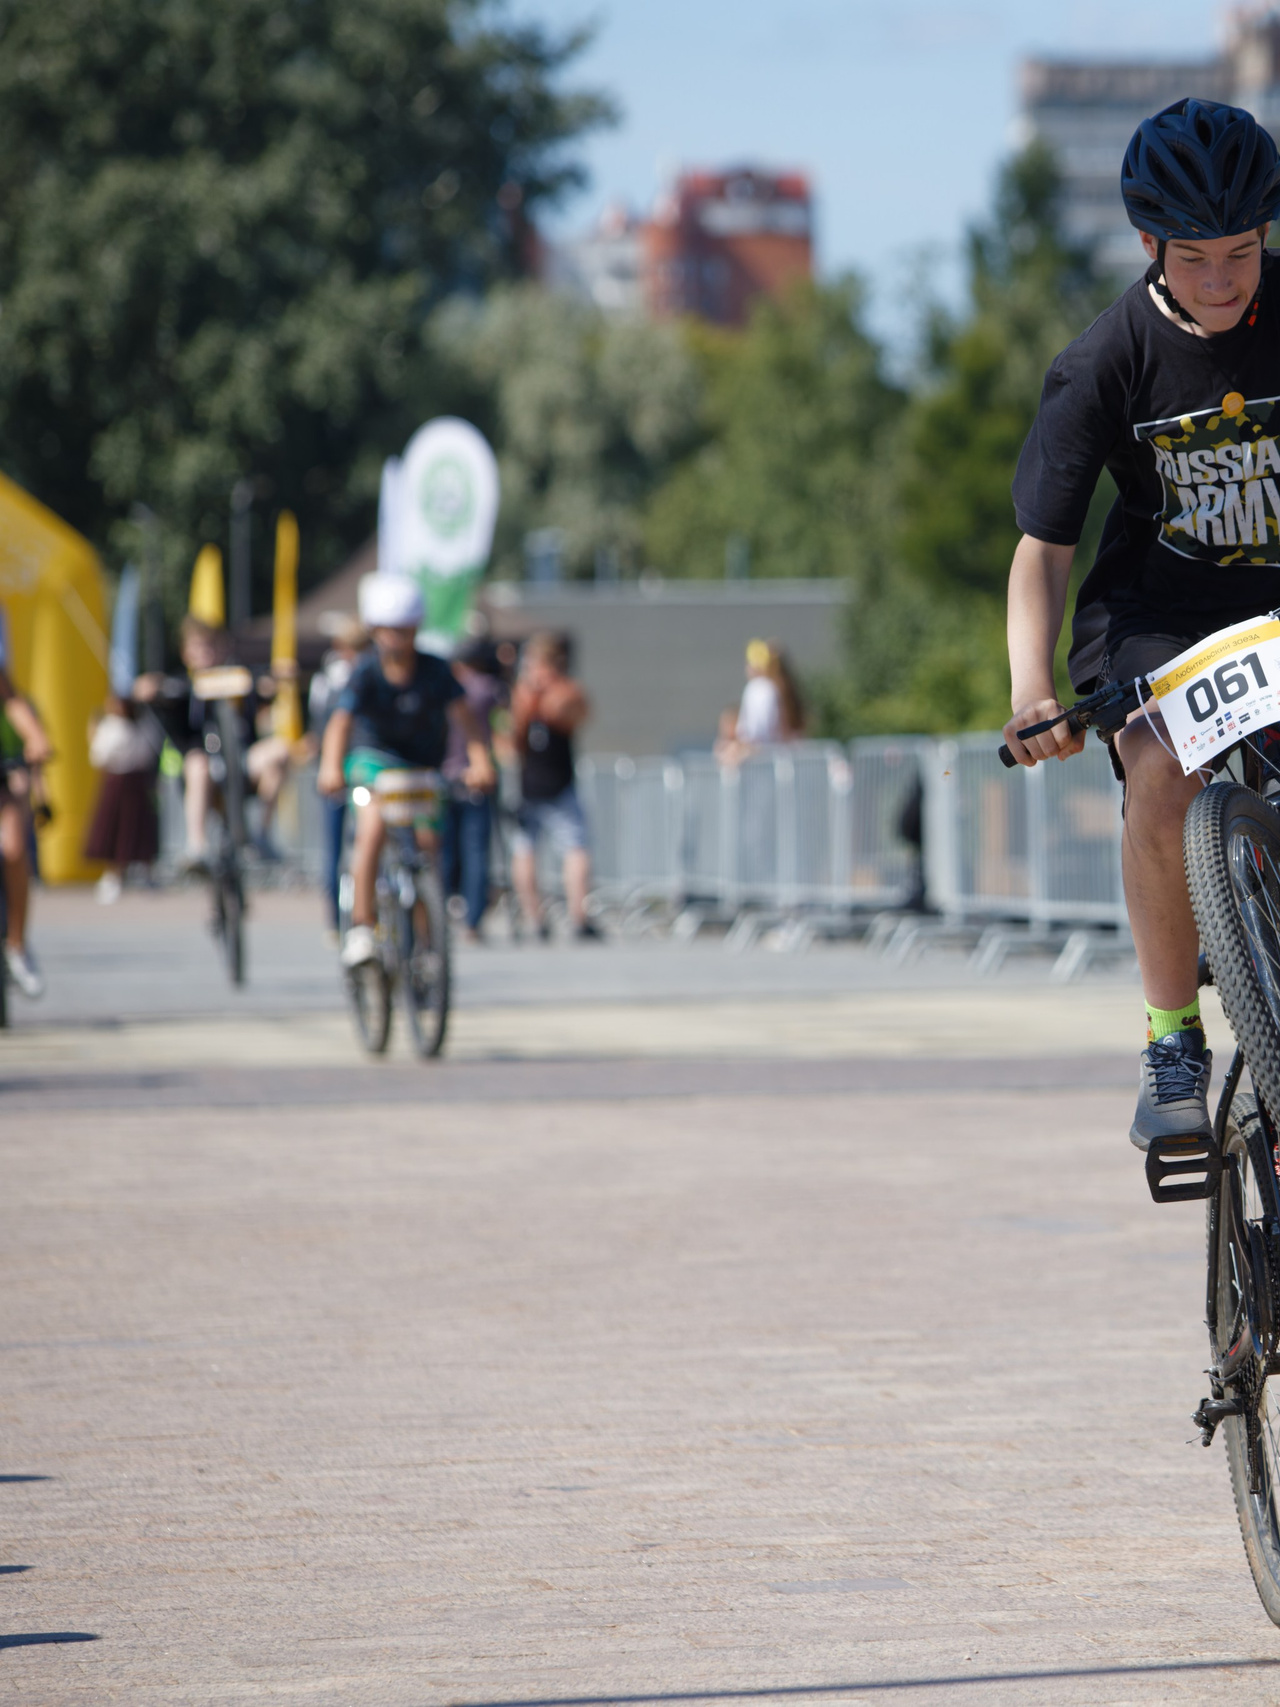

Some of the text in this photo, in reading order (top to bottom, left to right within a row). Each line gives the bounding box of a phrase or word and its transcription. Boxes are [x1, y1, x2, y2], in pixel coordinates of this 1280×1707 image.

[1175, 633, 1261, 681] Любительский заезд
[1185, 652, 1269, 723] 061
